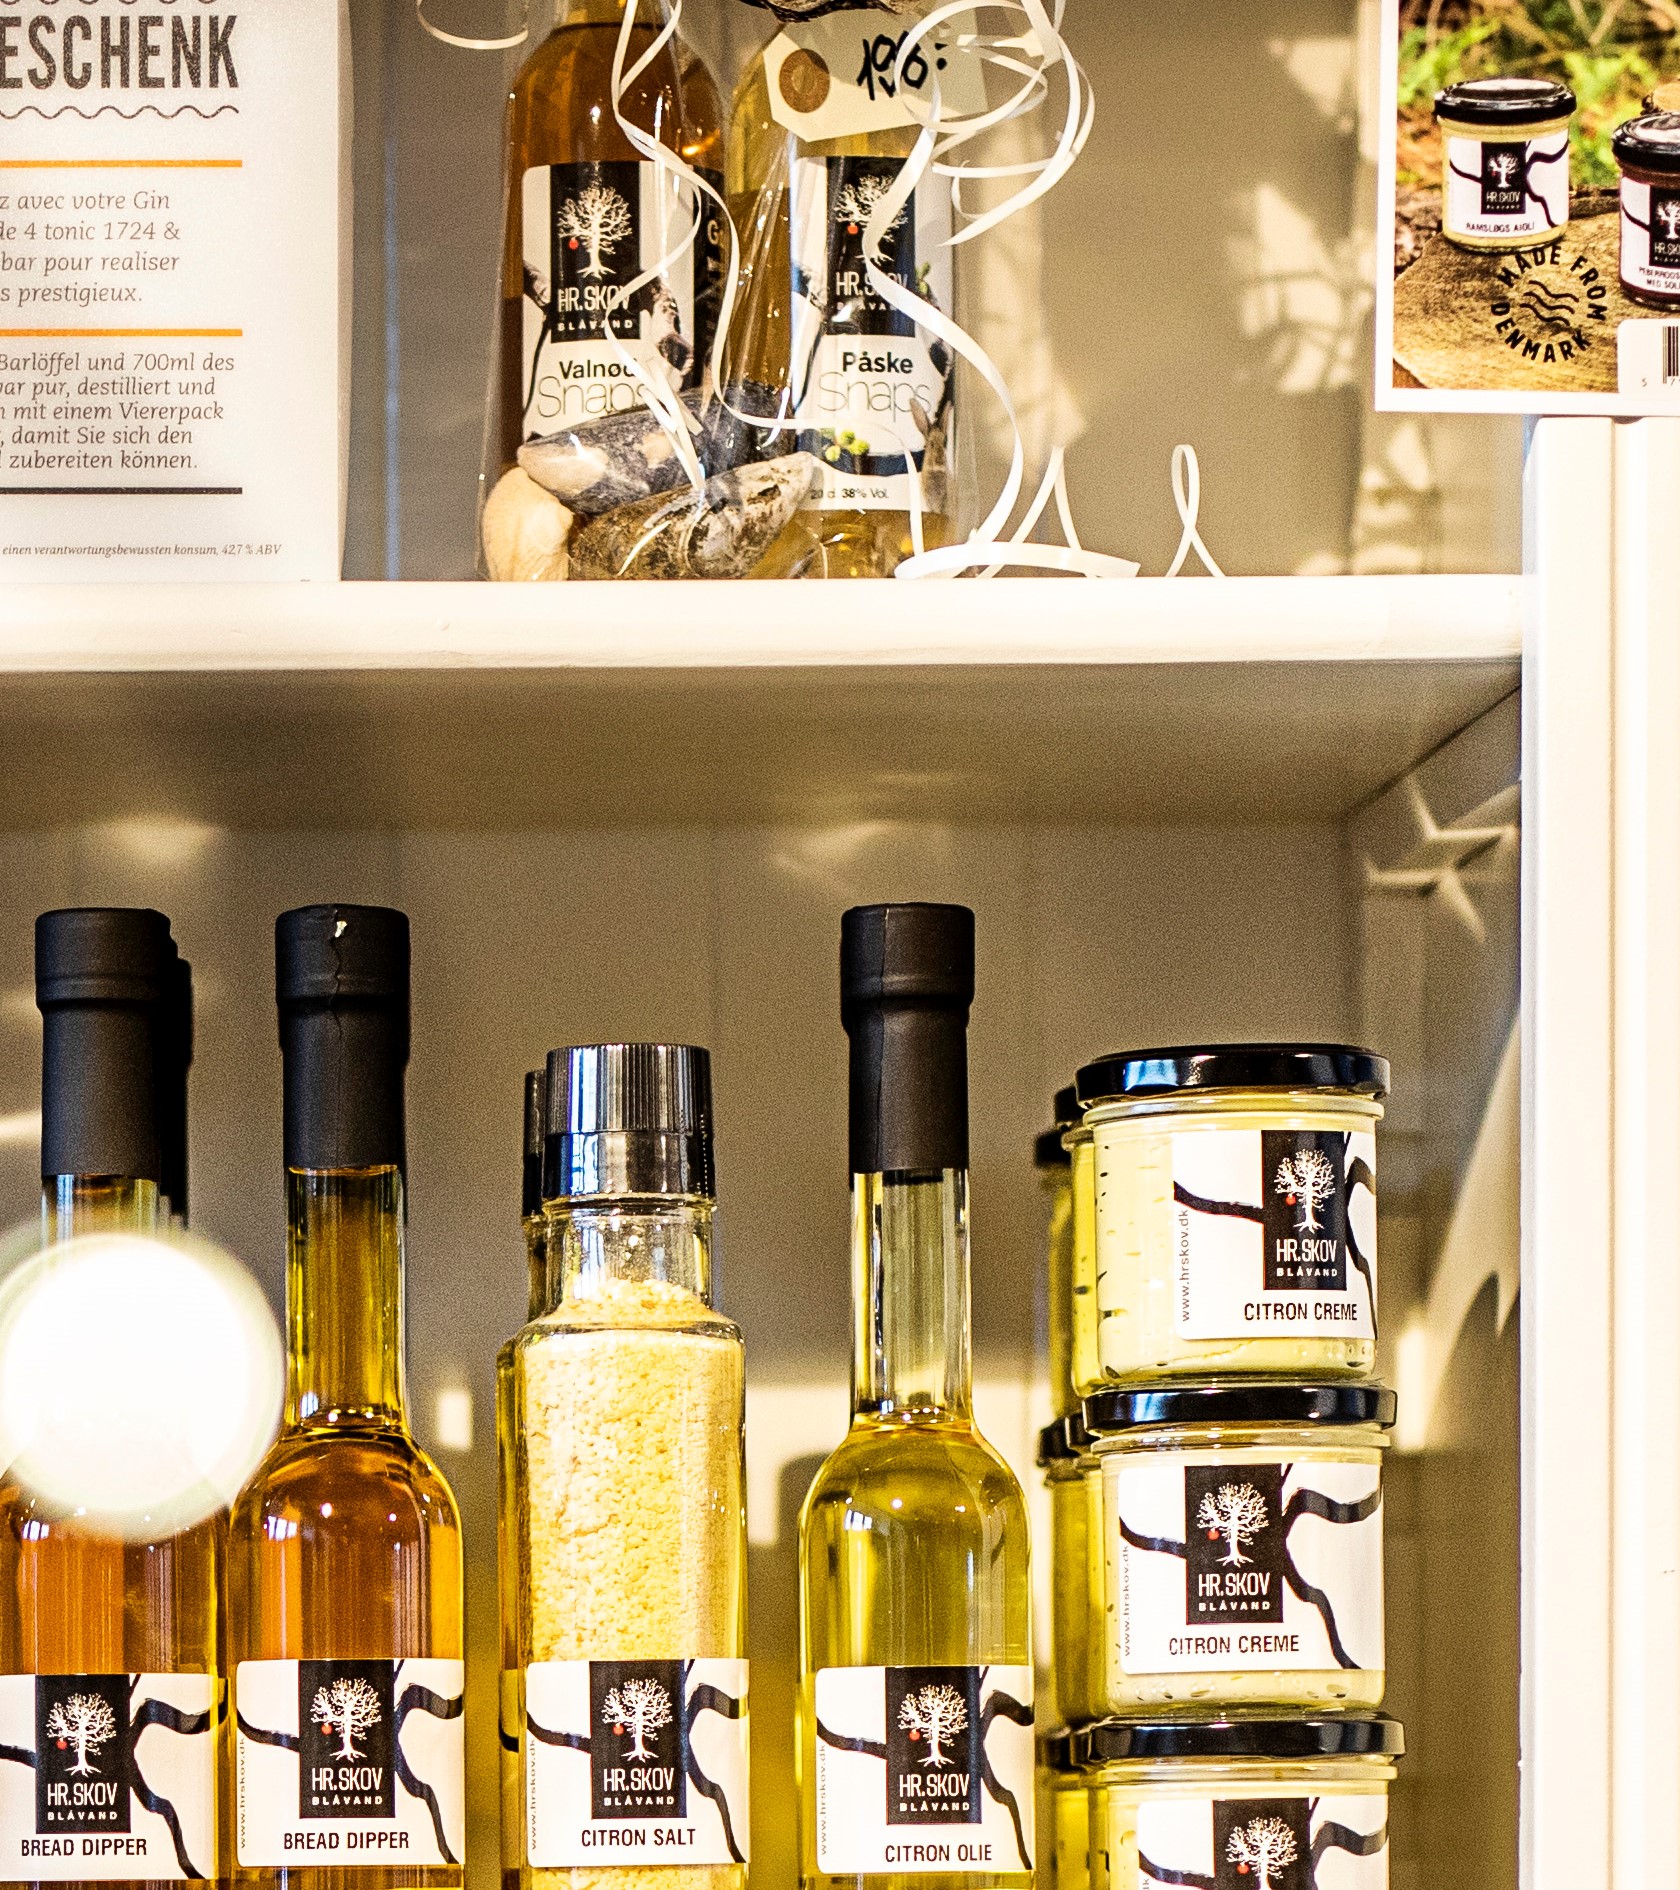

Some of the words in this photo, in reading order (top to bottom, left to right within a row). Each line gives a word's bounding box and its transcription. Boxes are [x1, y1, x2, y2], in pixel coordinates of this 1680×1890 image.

[16, 194, 65, 210] avec
[72, 193, 127, 211] votre
[133, 189, 170, 210] Gin
[23, 221, 38, 241] 4
[43, 222, 96, 241] tonic
[104, 220, 157, 241] 1724
[163, 221, 181, 241] &
[0, 251, 38, 272] bar
[43, 255, 94, 278] pour
[100, 251, 181, 272] realiser
[1496, 245, 1560, 288] MADE
[1570, 255, 1607, 321] FROM
[17, 281, 144, 308] prestigieux.
[1491, 301, 1591, 363] DENMARK
[86, 352, 125, 372] und
[131, 352, 195, 372] 700ml
[202, 352, 236, 372] des
[841, 351, 913, 376] Påske
[31, 381, 72, 401] pur,
[76, 376, 171, 396] destilliert
[178, 376, 216, 396] und
[817, 373, 931, 429] Snaps
[13, 401, 49, 421] mit
[52, 402, 113, 421] einem
[118, 400, 225, 426] Viererpack
[11, 425, 72, 445] damit
[75, 425, 107, 445] Sie
[111, 425, 152, 445] sich
[156, 425, 193, 445] den
[8, 450, 113, 469] zubereiten
[119, 450, 198, 469] können.
[1243, 1302, 1308, 1321] CITRON
[1313, 1302, 1358, 1322] CREME
[311, 1767, 383, 1792] HR.SKOV
[311, 1794, 383, 1806] BLÅVAND
[283, 1832, 340, 1850] BREAD
[347, 1831, 409, 1849] DIPPER
[581, 1828, 646, 1848] CITRON
[653, 1828, 696, 1847] SALT
[884, 1844, 950, 1863] CITRON
[957, 1843, 992, 1862] OLIE
